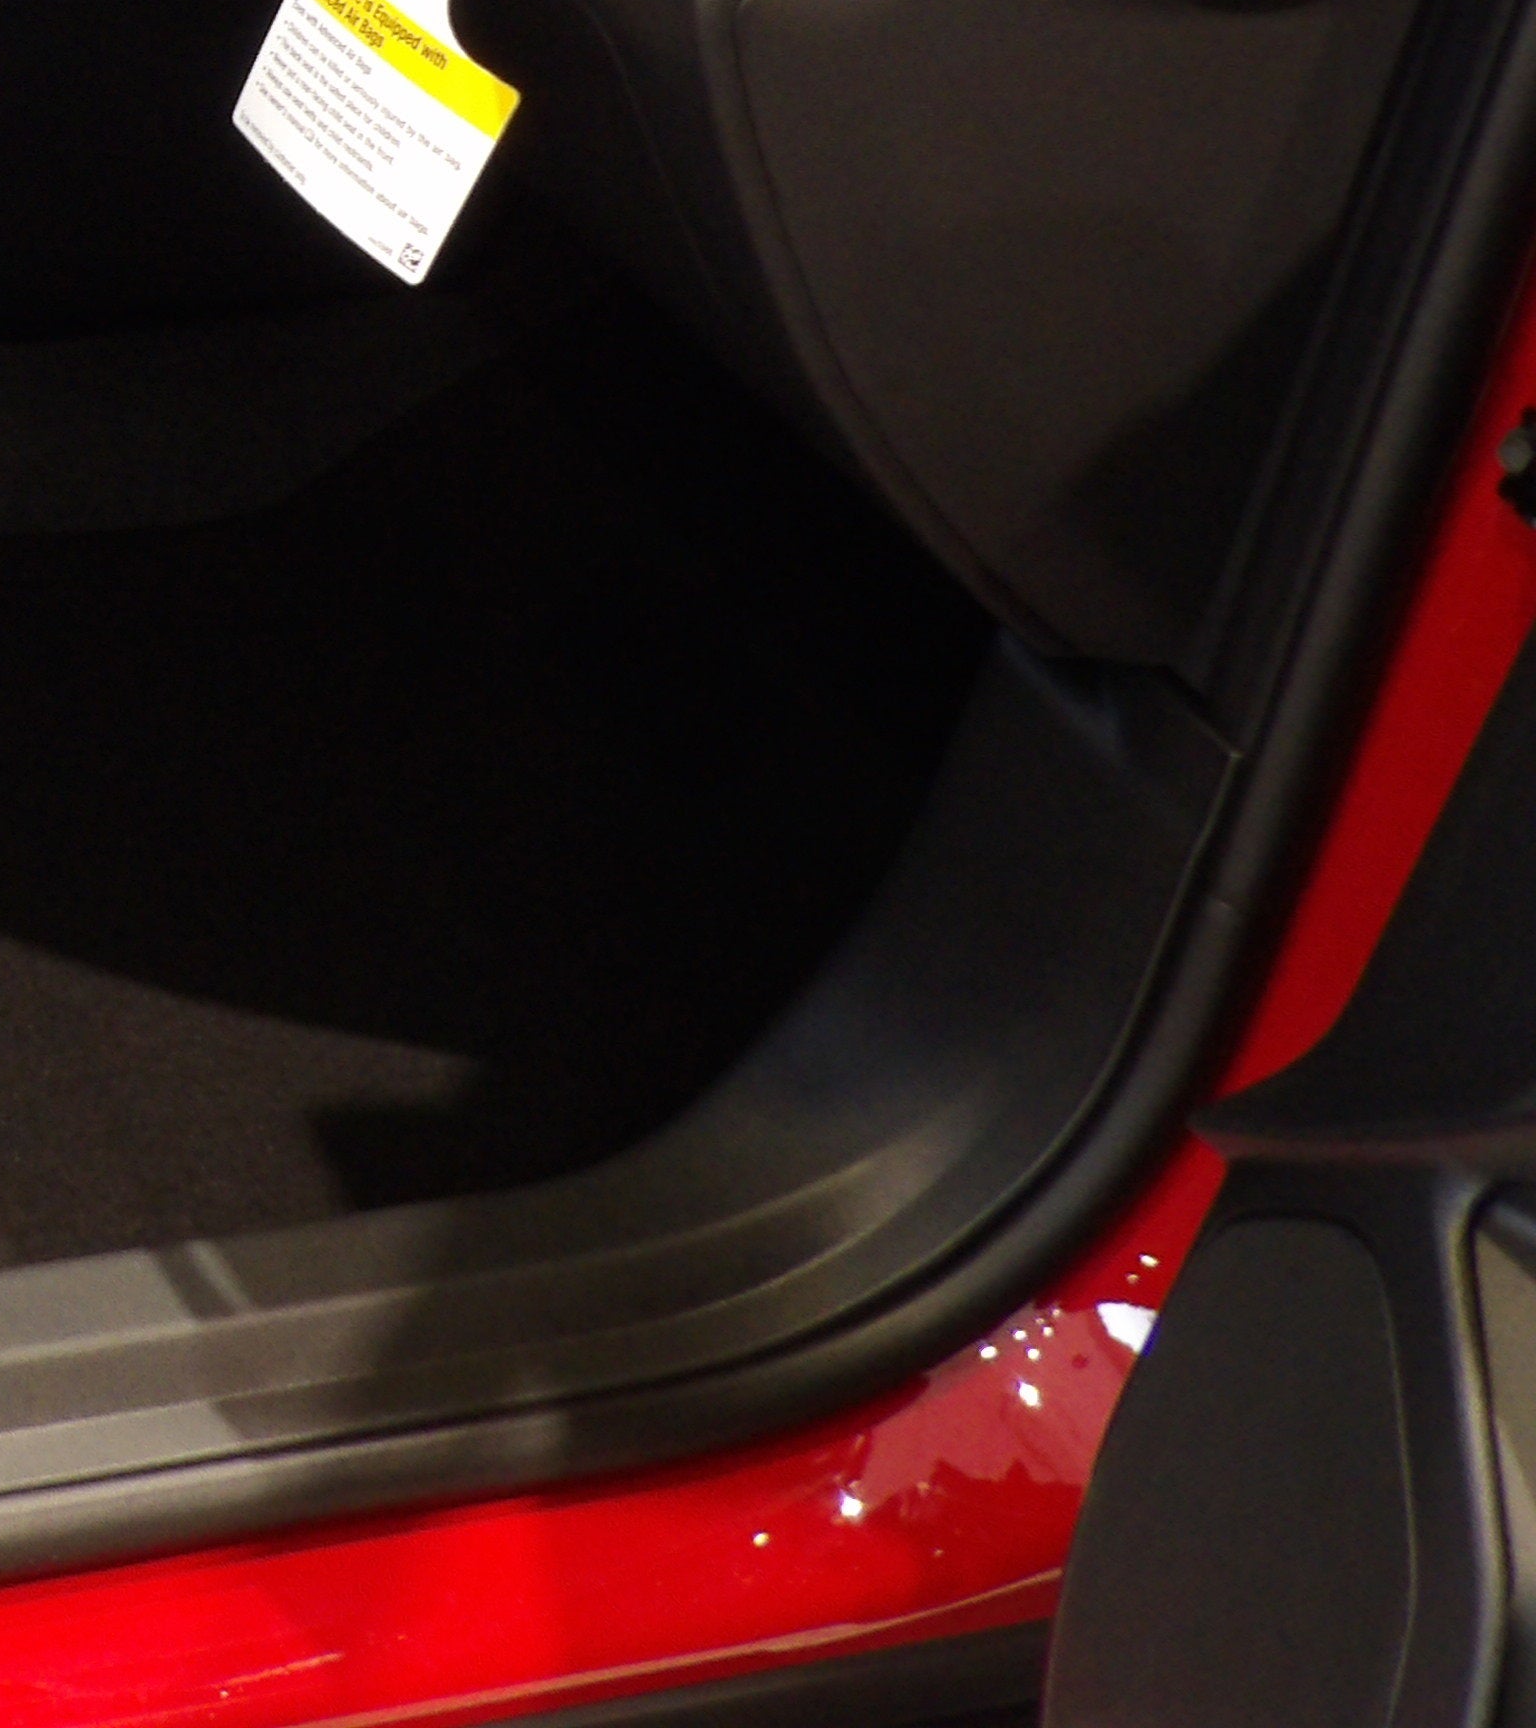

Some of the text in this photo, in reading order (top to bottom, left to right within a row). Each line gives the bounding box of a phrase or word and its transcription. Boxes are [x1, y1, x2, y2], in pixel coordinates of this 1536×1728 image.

[343, 7, 360, 25] Air
[358, 18, 384, 47] Bags
[372, 3, 422, 49] Equipped
[420, 45, 447, 69] with
